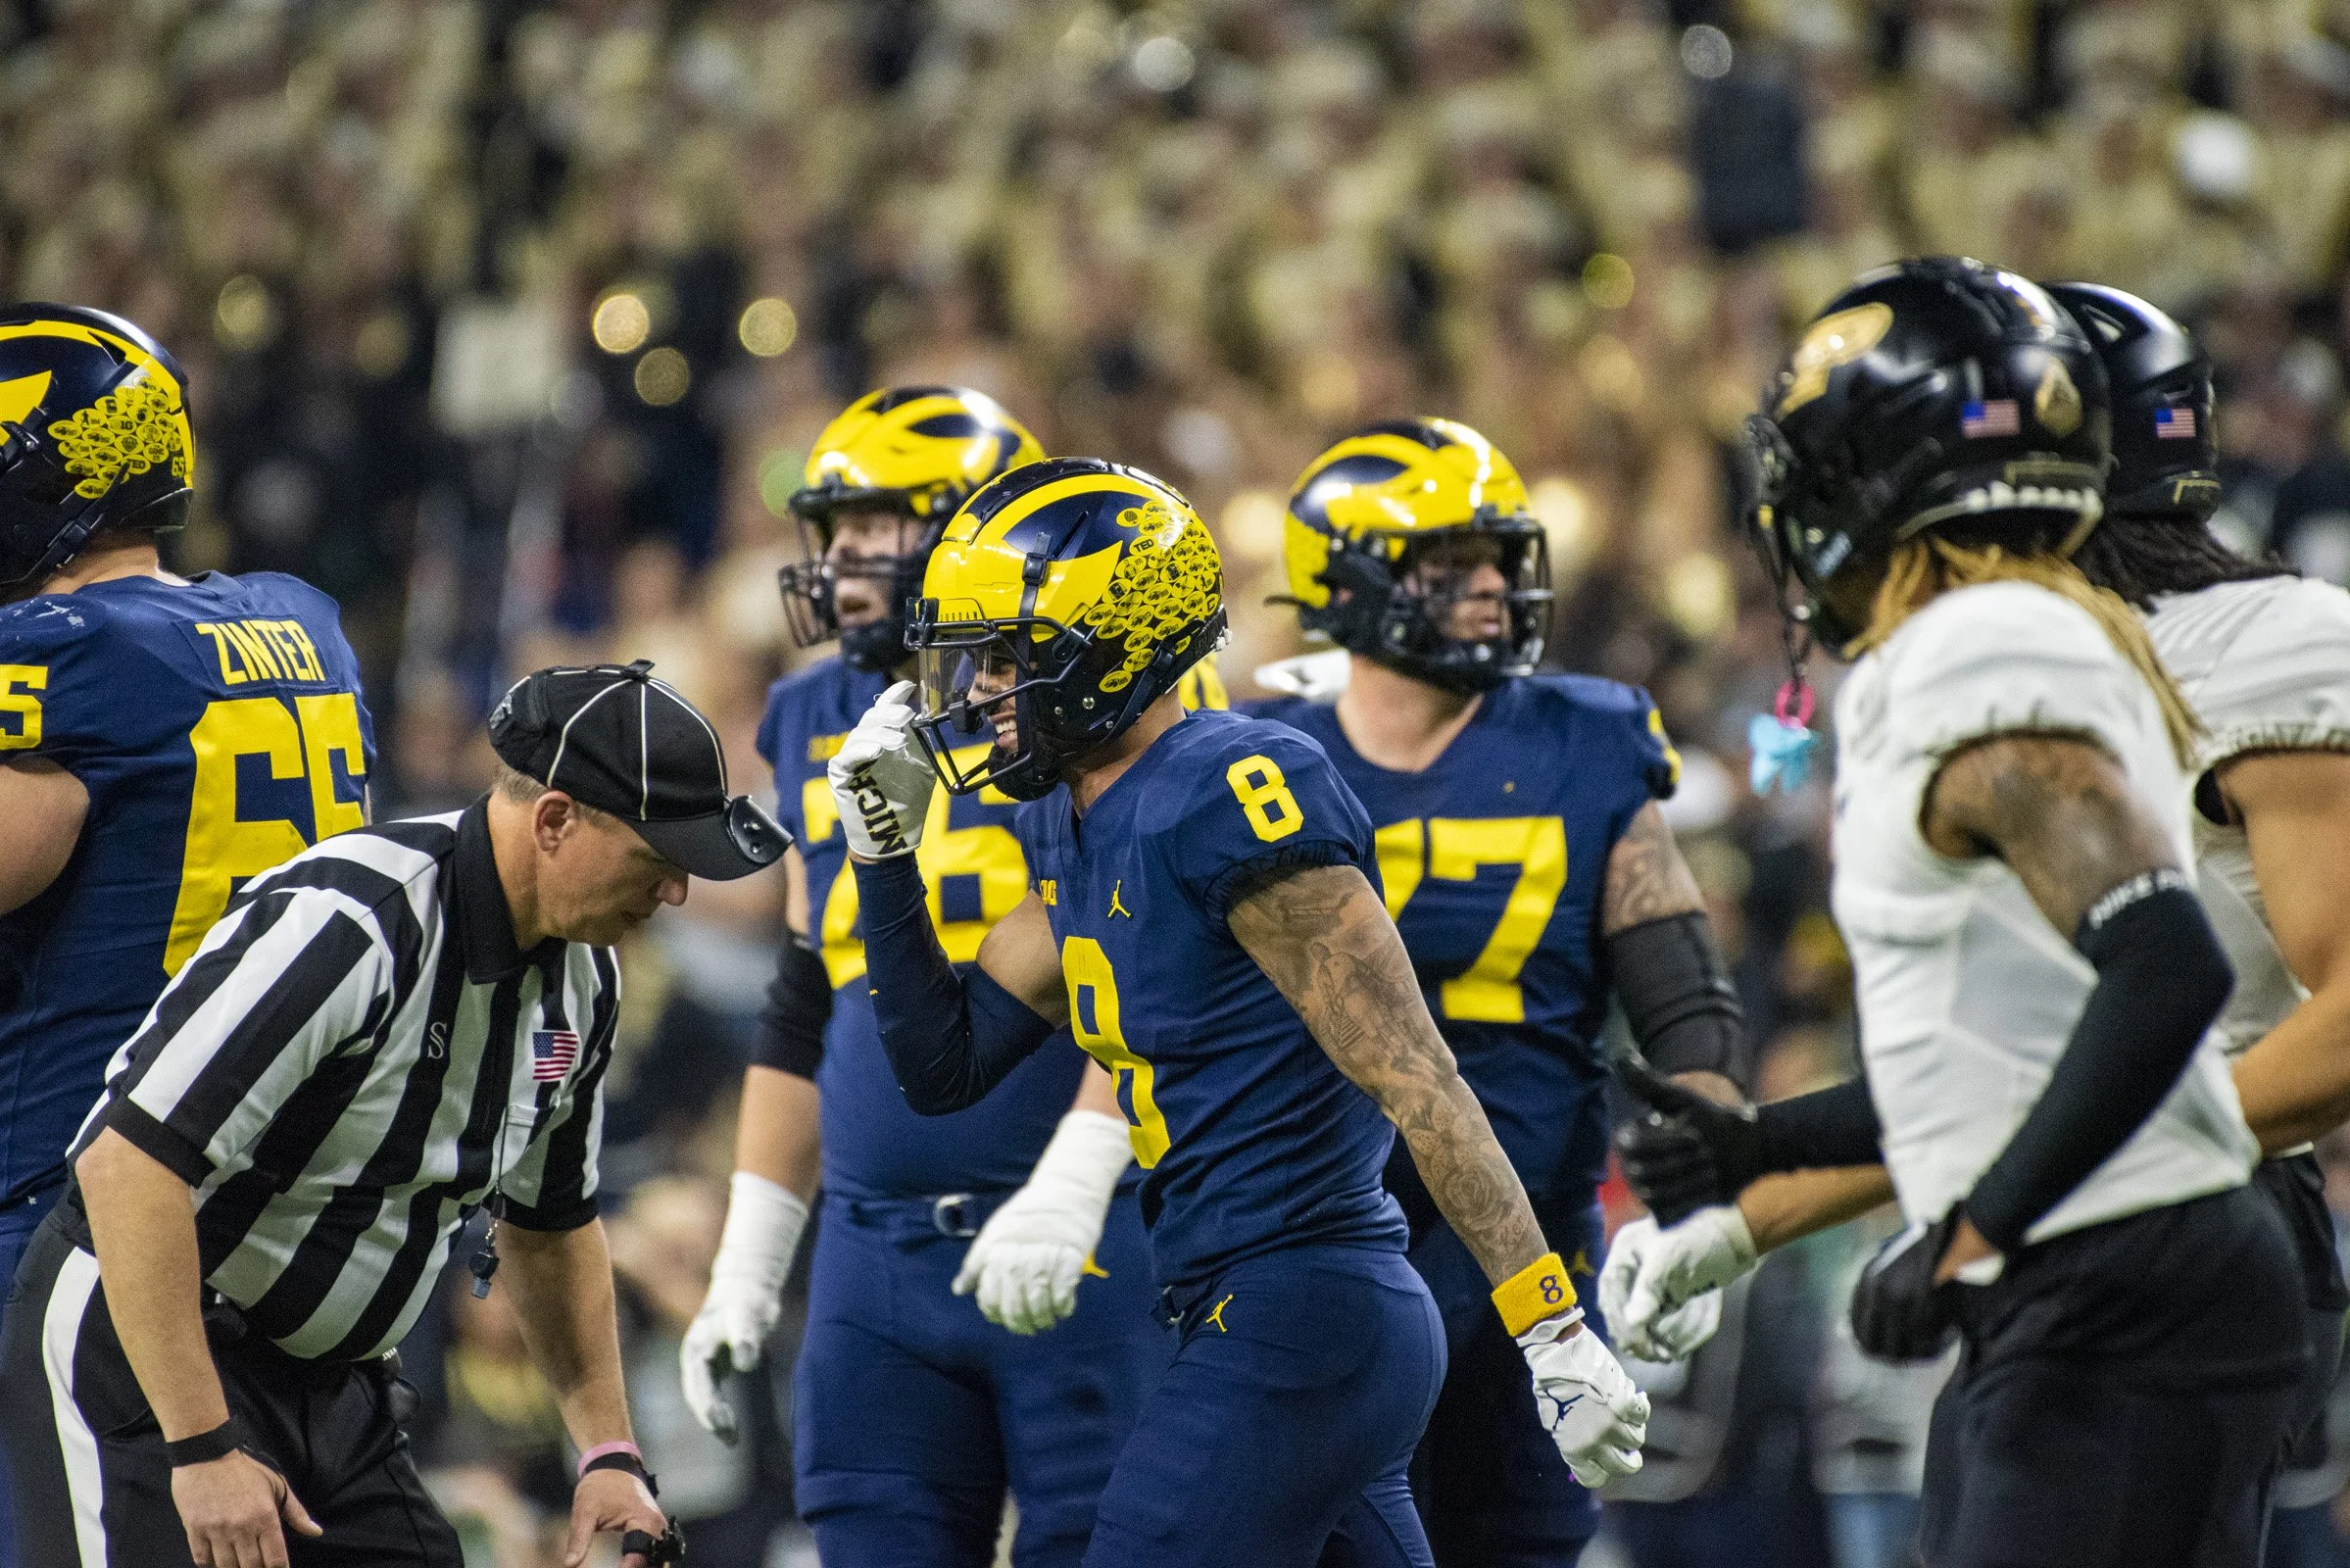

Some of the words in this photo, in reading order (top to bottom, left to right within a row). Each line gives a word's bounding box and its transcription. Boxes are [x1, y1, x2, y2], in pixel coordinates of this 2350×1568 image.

[1134, 538, 1154, 553] TED
[195, 619, 325, 685] ZINTER
[1226, 755, 1303, 842] 8
[1061, 936, 1171, 1170] 8
[1540, 1275, 1564, 1304] 8
